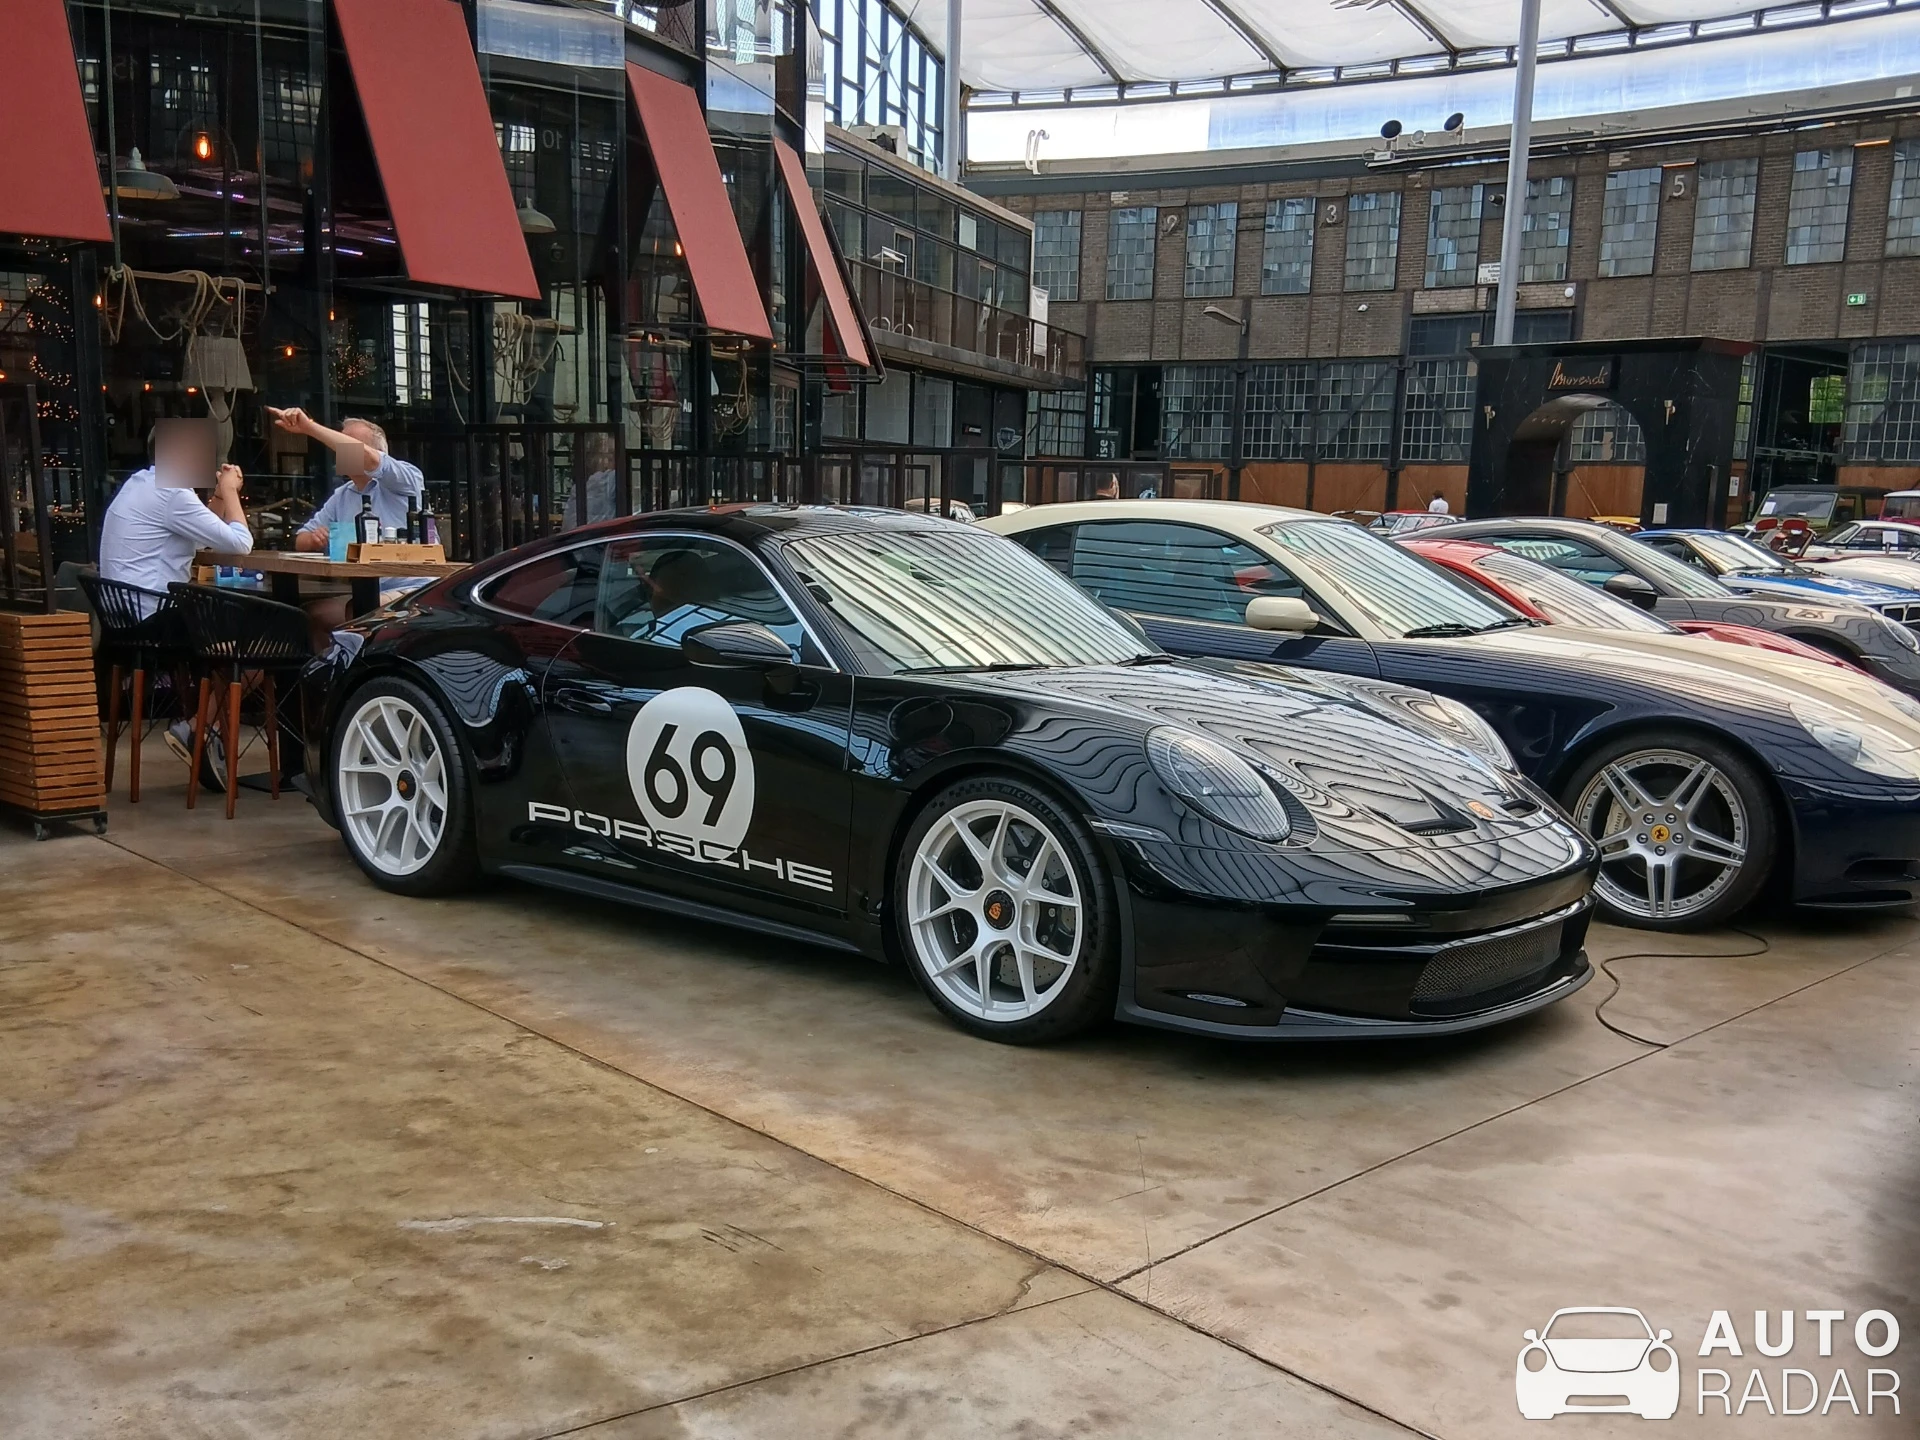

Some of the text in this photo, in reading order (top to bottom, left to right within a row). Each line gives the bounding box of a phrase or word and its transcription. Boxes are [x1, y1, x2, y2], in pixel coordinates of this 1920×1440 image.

[1672, 174, 1685, 197] 5
[1326, 204, 1337, 223] 3
[644, 723, 736, 828] 69
[1002, 784, 1059, 822] MICHELIN
[528, 801, 833, 892] PORSCHE
